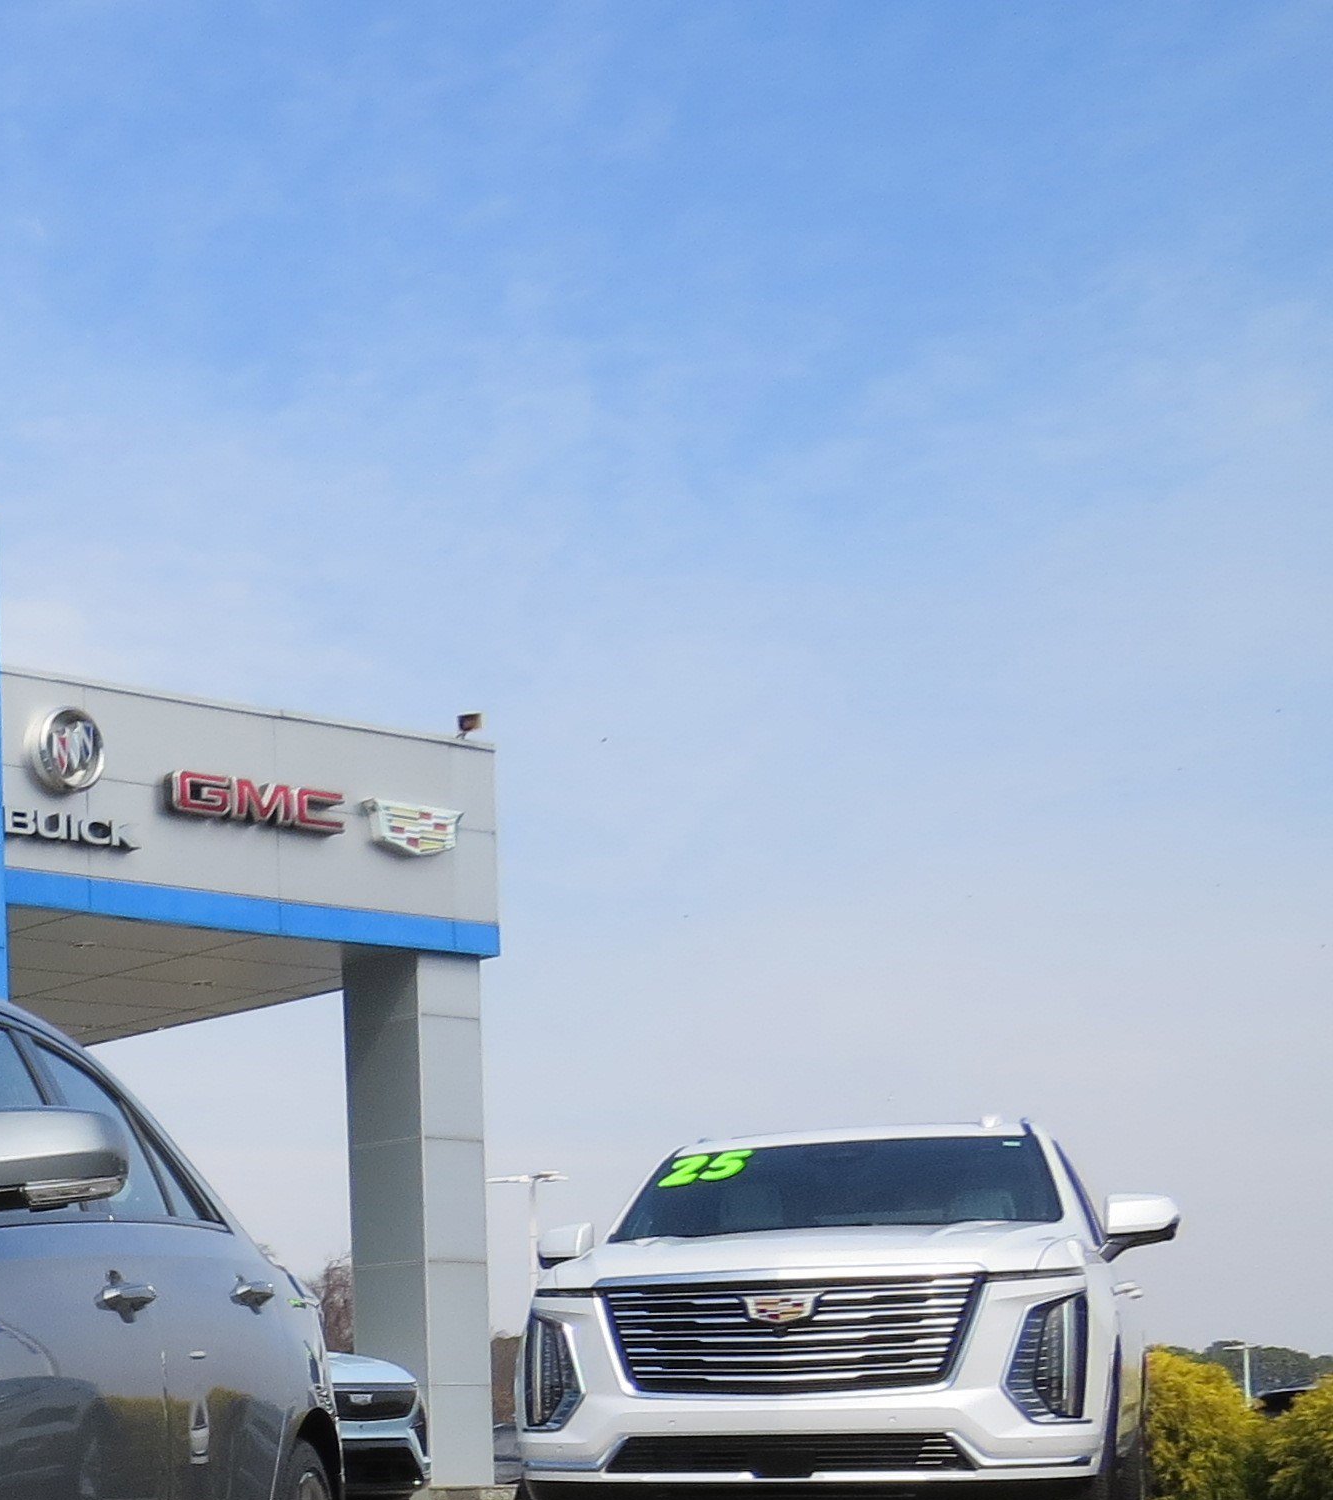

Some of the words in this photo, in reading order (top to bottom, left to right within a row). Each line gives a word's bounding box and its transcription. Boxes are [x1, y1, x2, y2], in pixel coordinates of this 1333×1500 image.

[165, 769, 346, 835] GMC
[4, 806, 141, 851] BUICK
[656, 1148, 756, 1189] 25
